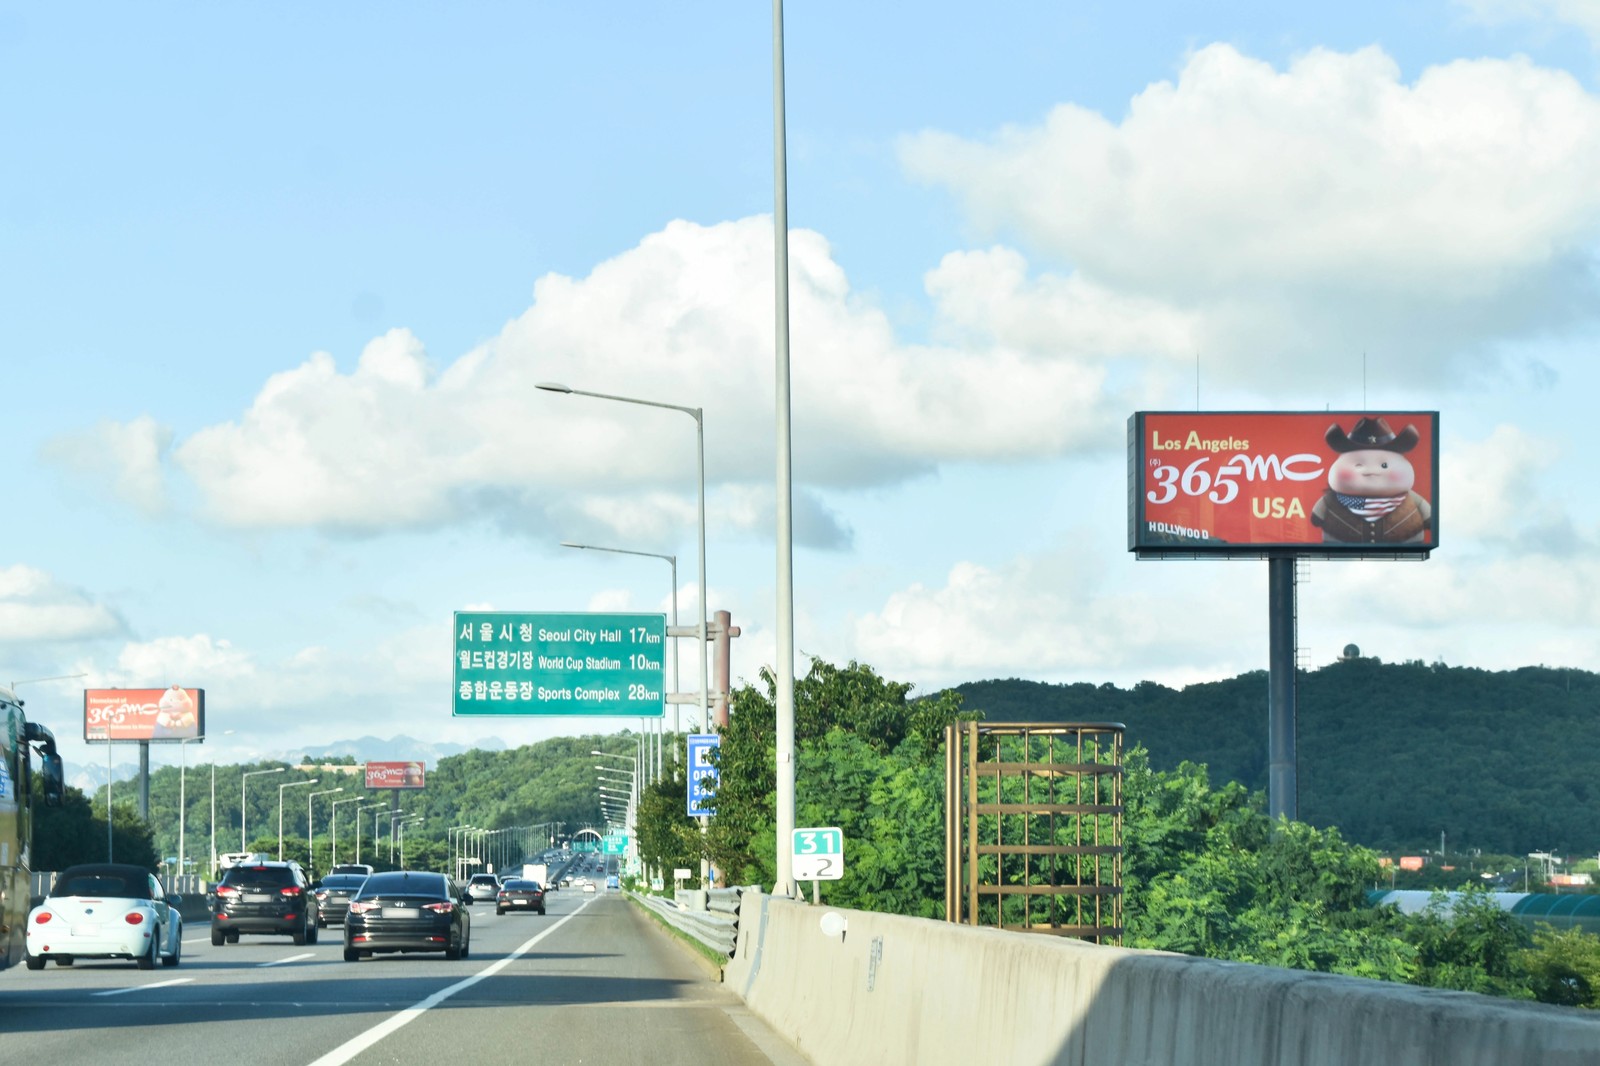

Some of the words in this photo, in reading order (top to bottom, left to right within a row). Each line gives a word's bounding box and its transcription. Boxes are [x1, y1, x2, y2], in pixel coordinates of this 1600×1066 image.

[1152, 430, 1181, 450] Los
[1184, 430, 1249, 453] Angeles
[1252, 497, 1306, 519] USA
[1149, 521, 1209, 540] HOLLYWOOD
[538, 629, 570, 642] Seoul
[574, 629, 596, 645] City
[600, 629, 621, 642] Hall
[459, 650, 533, 670] 월드컵경기장
[538, 655, 563, 670] World
[566, 657, 583, 672] Cup
[586, 657, 620, 670] Stadium
[459, 681, 533, 700] 종합운동장
[538, 687, 571, 702] Sports
[574, 688, 620, 703] Complex
[800, 832, 833, 853] 31
